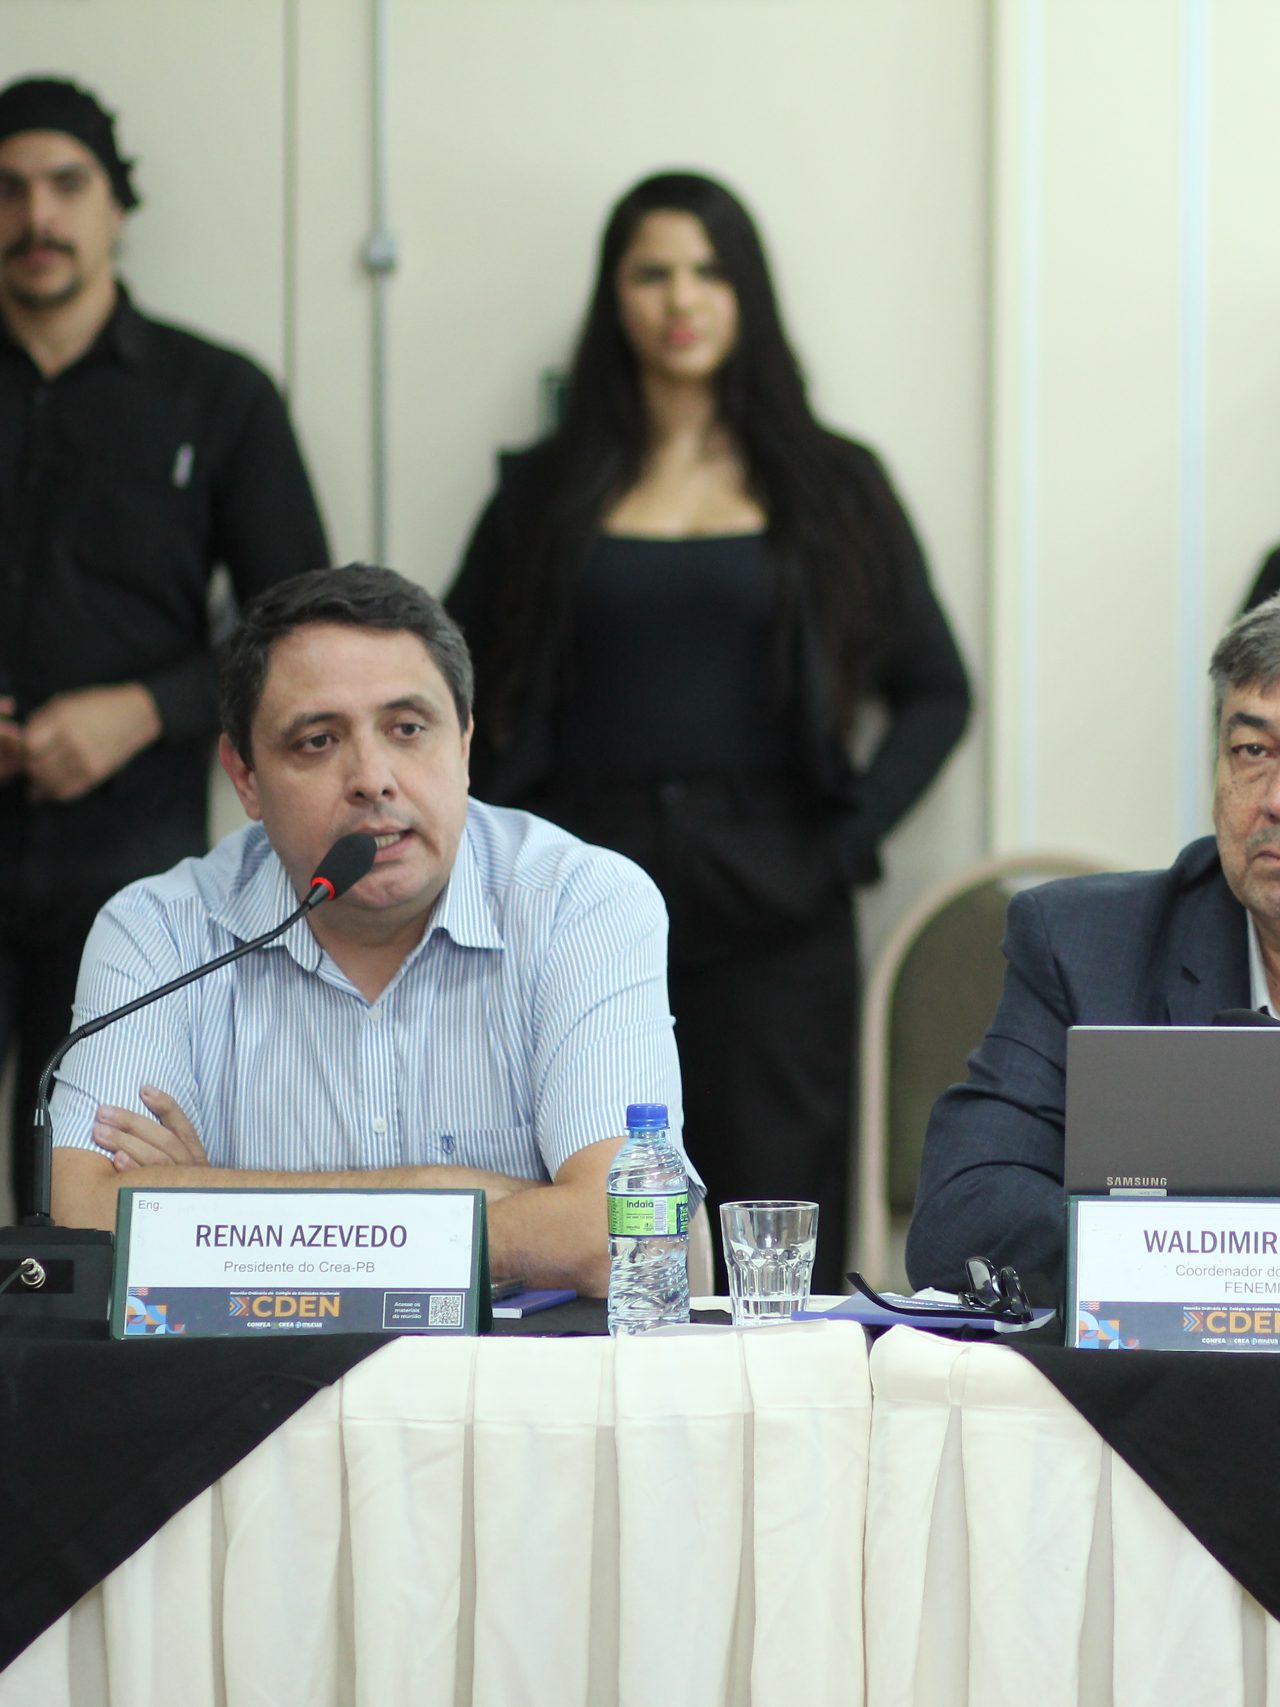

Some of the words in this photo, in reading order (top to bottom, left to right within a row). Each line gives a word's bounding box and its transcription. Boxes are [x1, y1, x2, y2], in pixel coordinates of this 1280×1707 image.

[1106, 1176, 1168, 1186] SAMSUNG
[138, 1200, 162, 1212] Eng.
[195, 1224, 284, 1247] RENAN
[289, 1224, 408, 1248] AZEVEDO
[1143, 1229, 1279, 1255] WALDIMIR
[223, 1261, 294, 1273] Presidente
[298, 1261, 315, 1273] do
[318, 1261, 375, 1273] Crea-PB
[1175, 1264, 1263, 1278] Coordenador
[1224, 1281, 1280, 1294] FENEMI
[252, 1296, 339, 1317] CDEN
